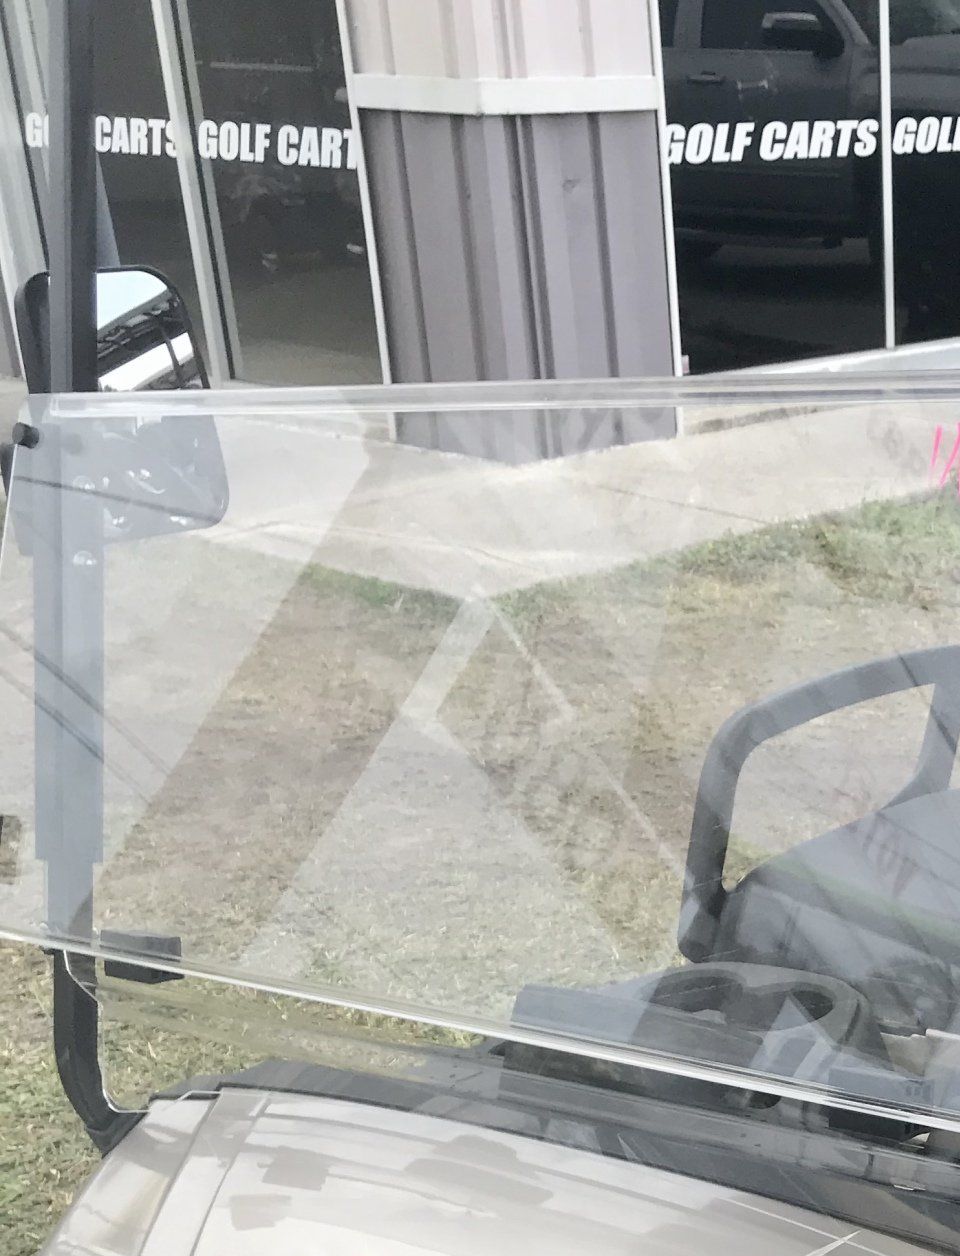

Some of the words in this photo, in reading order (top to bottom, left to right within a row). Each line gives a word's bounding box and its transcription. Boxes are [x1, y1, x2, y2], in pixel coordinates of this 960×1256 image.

[95, 115, 177, 158] CARTS
[198, 120, 270, 163] GOLF
[277, 124, 357, 170] CART
[665, 122, 755, 165] GOLF
[760, 119, 879, 161] CARTS
